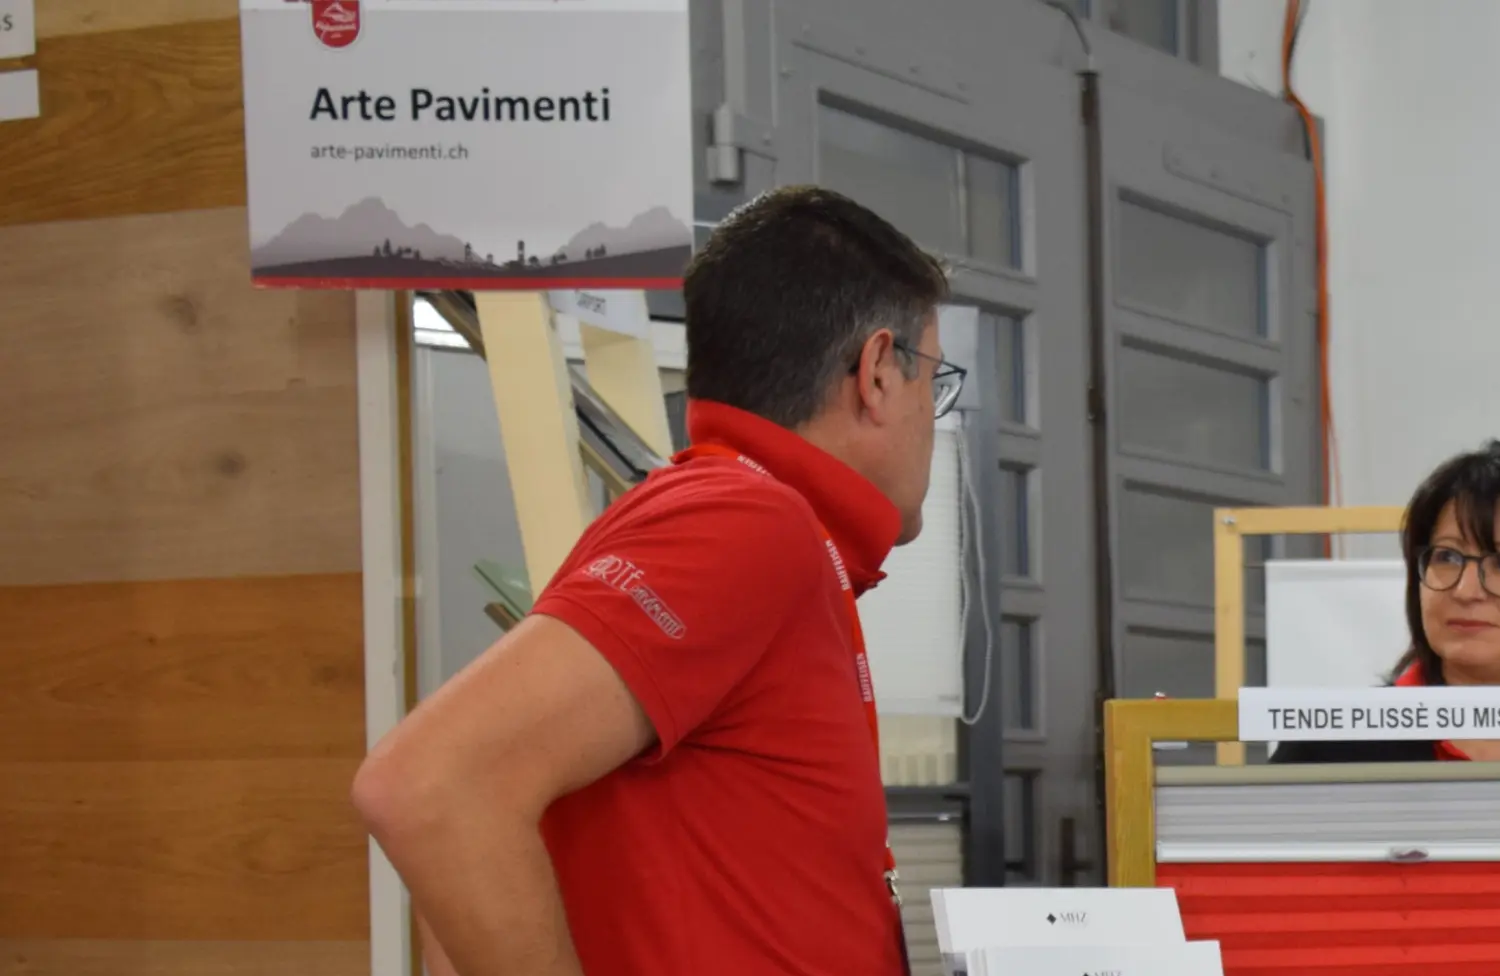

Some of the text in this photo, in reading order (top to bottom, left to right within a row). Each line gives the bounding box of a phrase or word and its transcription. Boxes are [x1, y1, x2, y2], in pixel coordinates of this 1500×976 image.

[309, 87, 610, 121] Arte Pavimenti
[310, 143, 469, 161] arte-pavimenti.ch
[1268, 708, 1343, 729] TENDE
[1351, 702, 1428, 729] PLISSÈ
[1437, 707, 1465, 728] SU
[1060, 911, 1087, 924] MHZ
